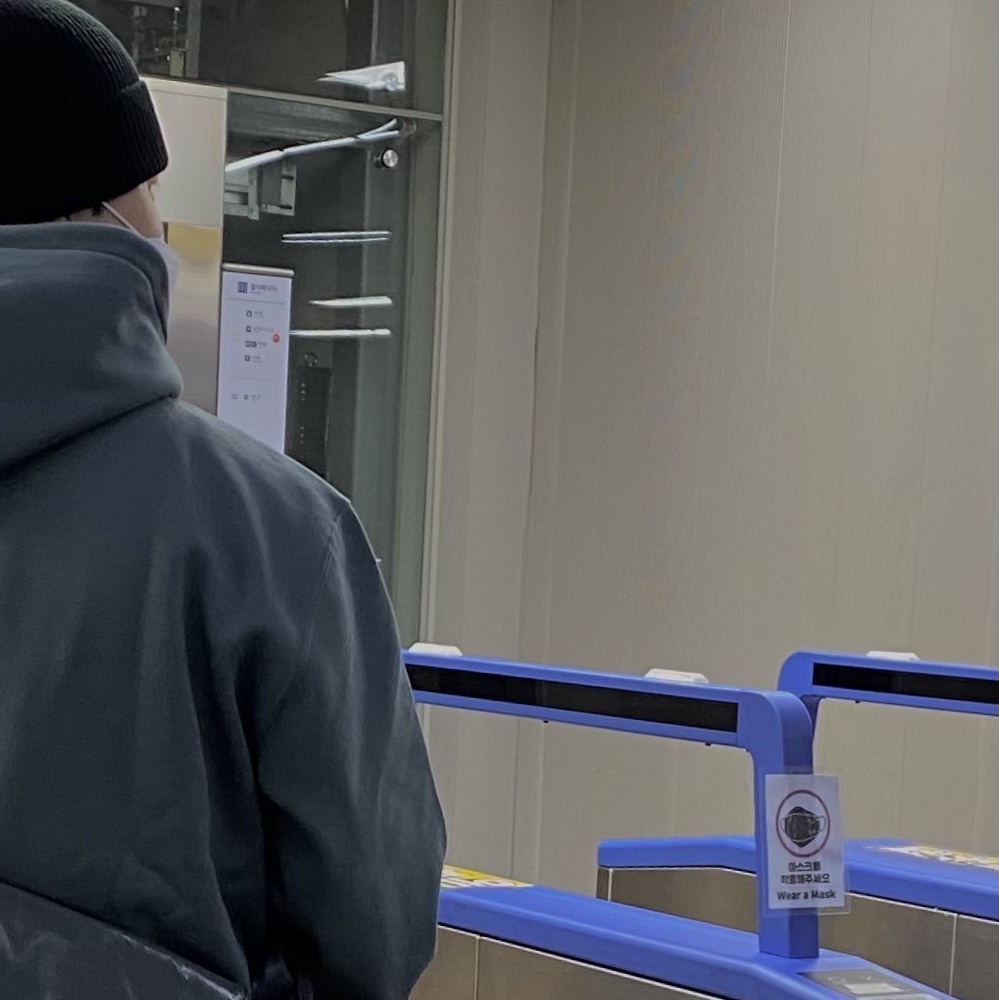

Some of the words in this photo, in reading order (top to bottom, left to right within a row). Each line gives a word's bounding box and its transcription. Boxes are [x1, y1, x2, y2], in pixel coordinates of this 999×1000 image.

[788, 861, 821, 872] 마스크를
[781, 873, 830, 884] 착용해주세요
[777, 890, 801, 900] Wear
[811, 889, 837, 899] Mask
